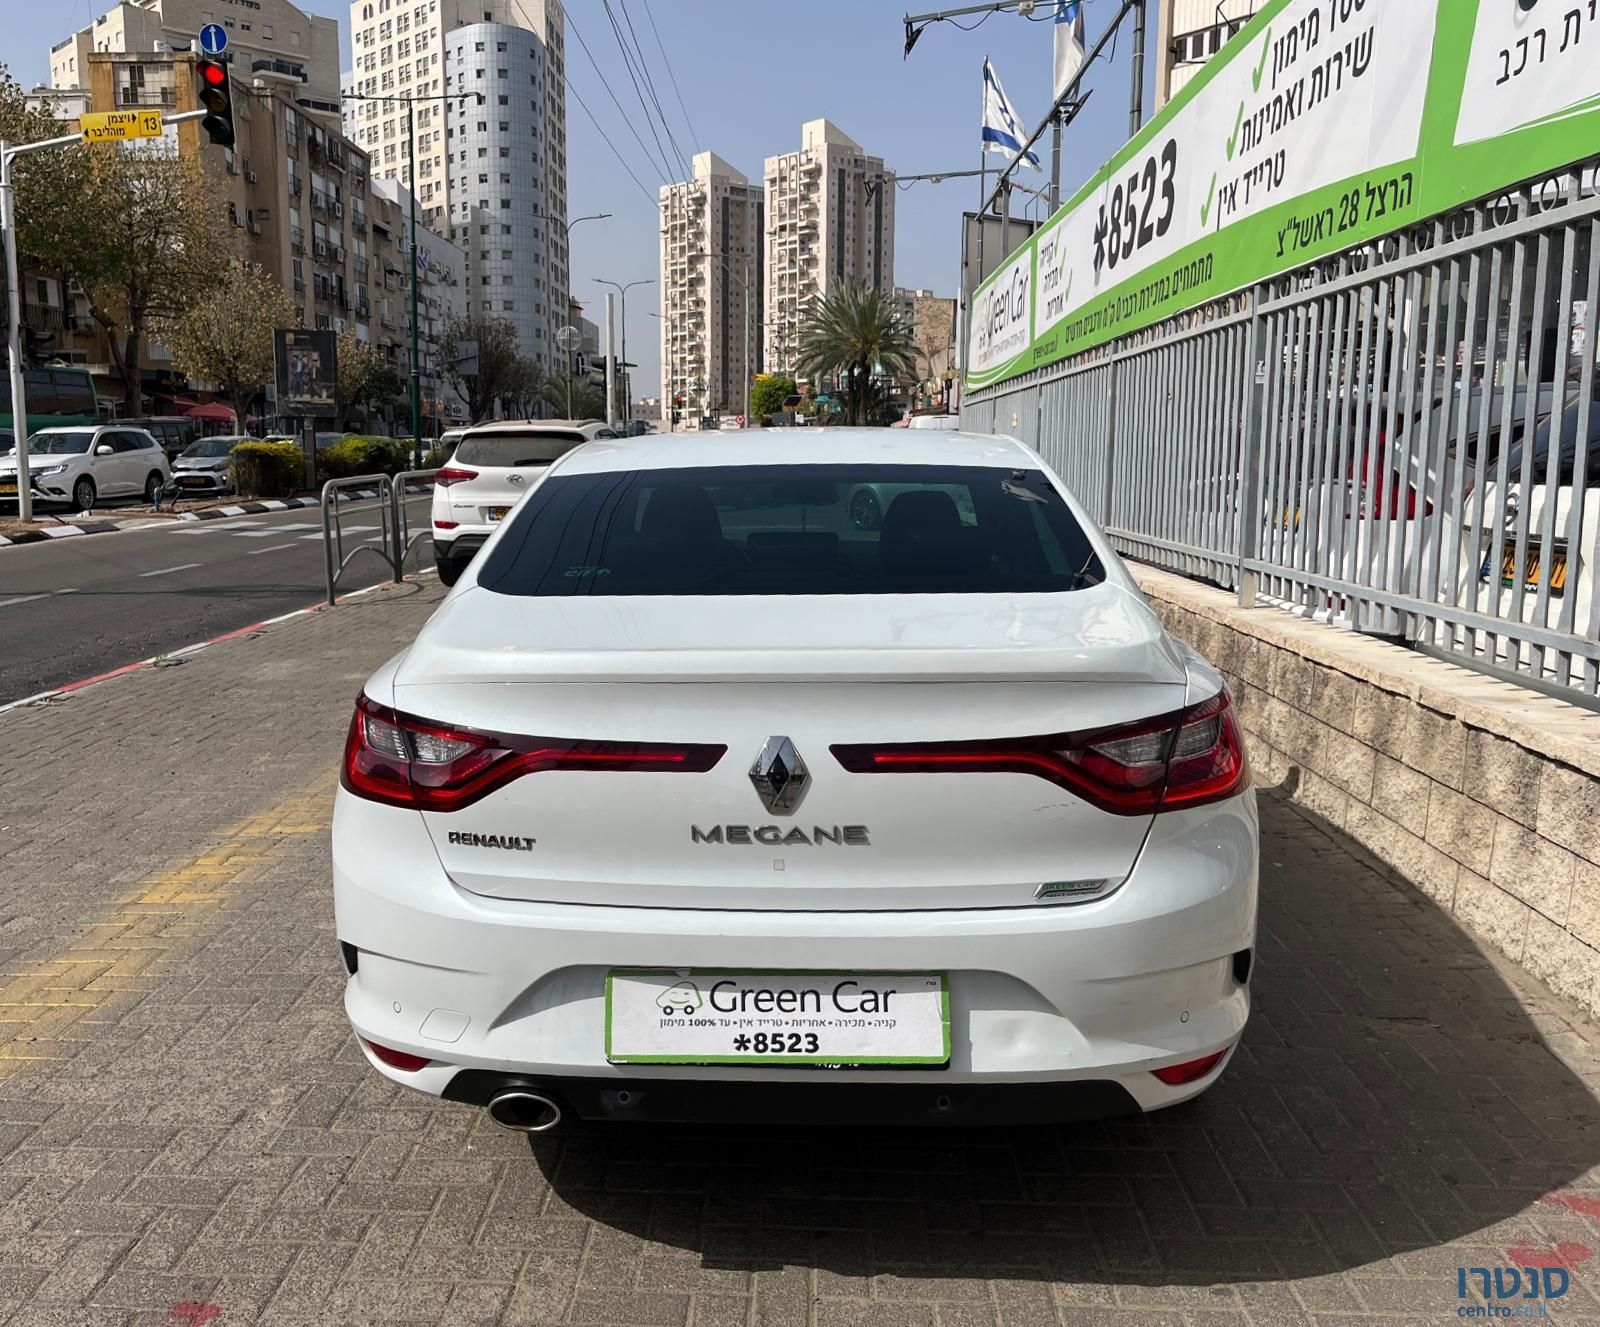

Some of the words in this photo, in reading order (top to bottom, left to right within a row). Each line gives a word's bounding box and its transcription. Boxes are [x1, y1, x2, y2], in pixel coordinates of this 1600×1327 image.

[1272, 7, 1320, 90] מימון
[1496, 28, 1546, 86] רכב
[1308, 25, 1374, 110] שירות
[107, 114, 130, 127] ויצמן
[144, 117, 157, 130] 13
[1239, 77, 1304, 157] ואמינות
[91, 125, 125, 137] מוהליבר
[1243, 149, 1286, 205] טרייד
[1217, 178, 1239, 231] אין
[1365, 172, 1413, 221] הרצל
[1337, 189, 1360, 233] 28
[1172, 252, 1213, 297] מתמחים
[1011, 267, 1029, 323] Car
[1139, 276, 1170, 312] במכירת
[448, 831, 536, 851] RENAULT
[691, 824, 871, 846] MEGANE
[709, 981, 821, 1013] Green
[832, 981, 896, 1013] Car
[660, 1018, 685, 1029] מימון
[688, 1018, 716, 1027] 100%
[718, 1018, 730, 1027] עד
[739, 1019, 753, 1029] אין
[757, 1018, 782, 1027] טרייד
[791, 1019, 826, 1027] אחריות
[835, 1019, 865, 1028] מכירה
[873, 1019, 896, 1029] קניה
